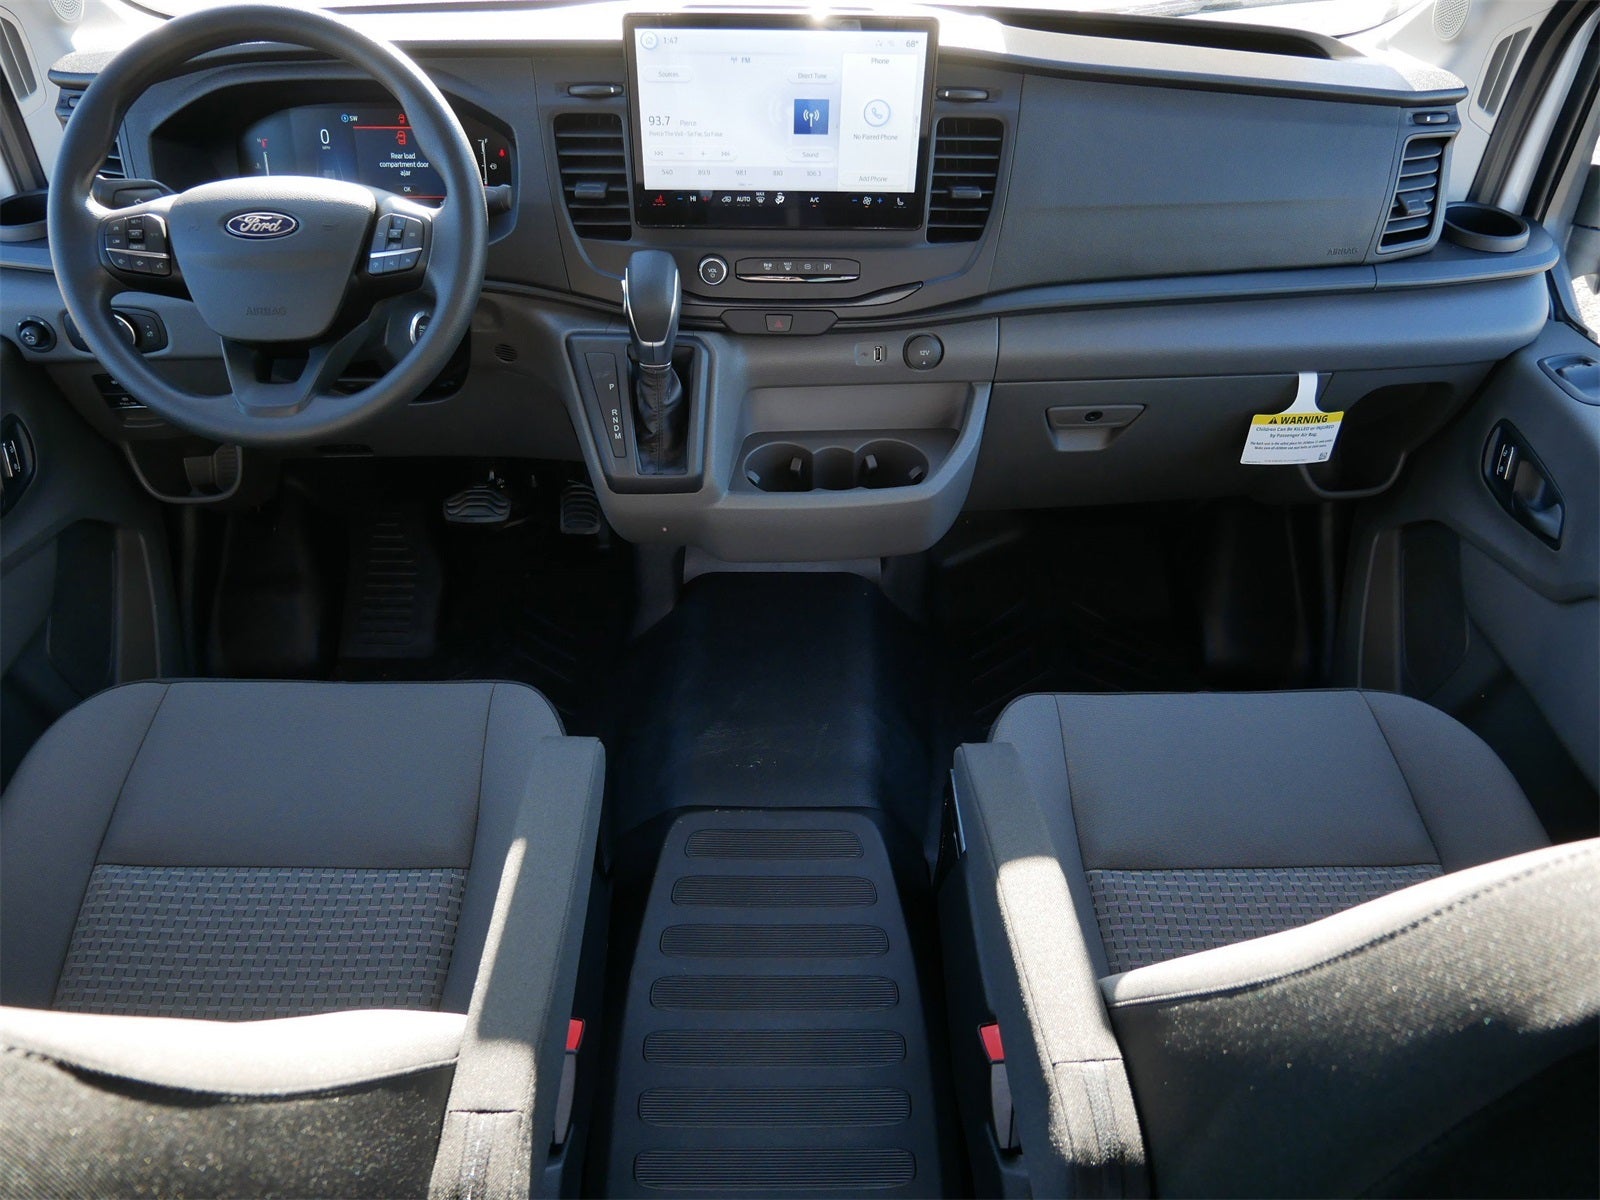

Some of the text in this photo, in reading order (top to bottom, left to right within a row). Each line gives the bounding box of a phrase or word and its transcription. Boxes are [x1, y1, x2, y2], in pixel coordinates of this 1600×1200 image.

[663, 36, 678, 45] 1:47
[741, 56, 751, 64] FM
[871, 57, 889, 65] Phone
[648, 115, 671, 126] 93.7
[320, 129, 330, 145] 0
[880, 133, 898, 141] Phone
[390, 152, 416, 160] Rear load
[379, 161, 416, 169] compartment
[399, 169, 411, 177] ajar
[240, 215, 281, 232] Ford
[1280, 414, 1328, 425] WARNING
